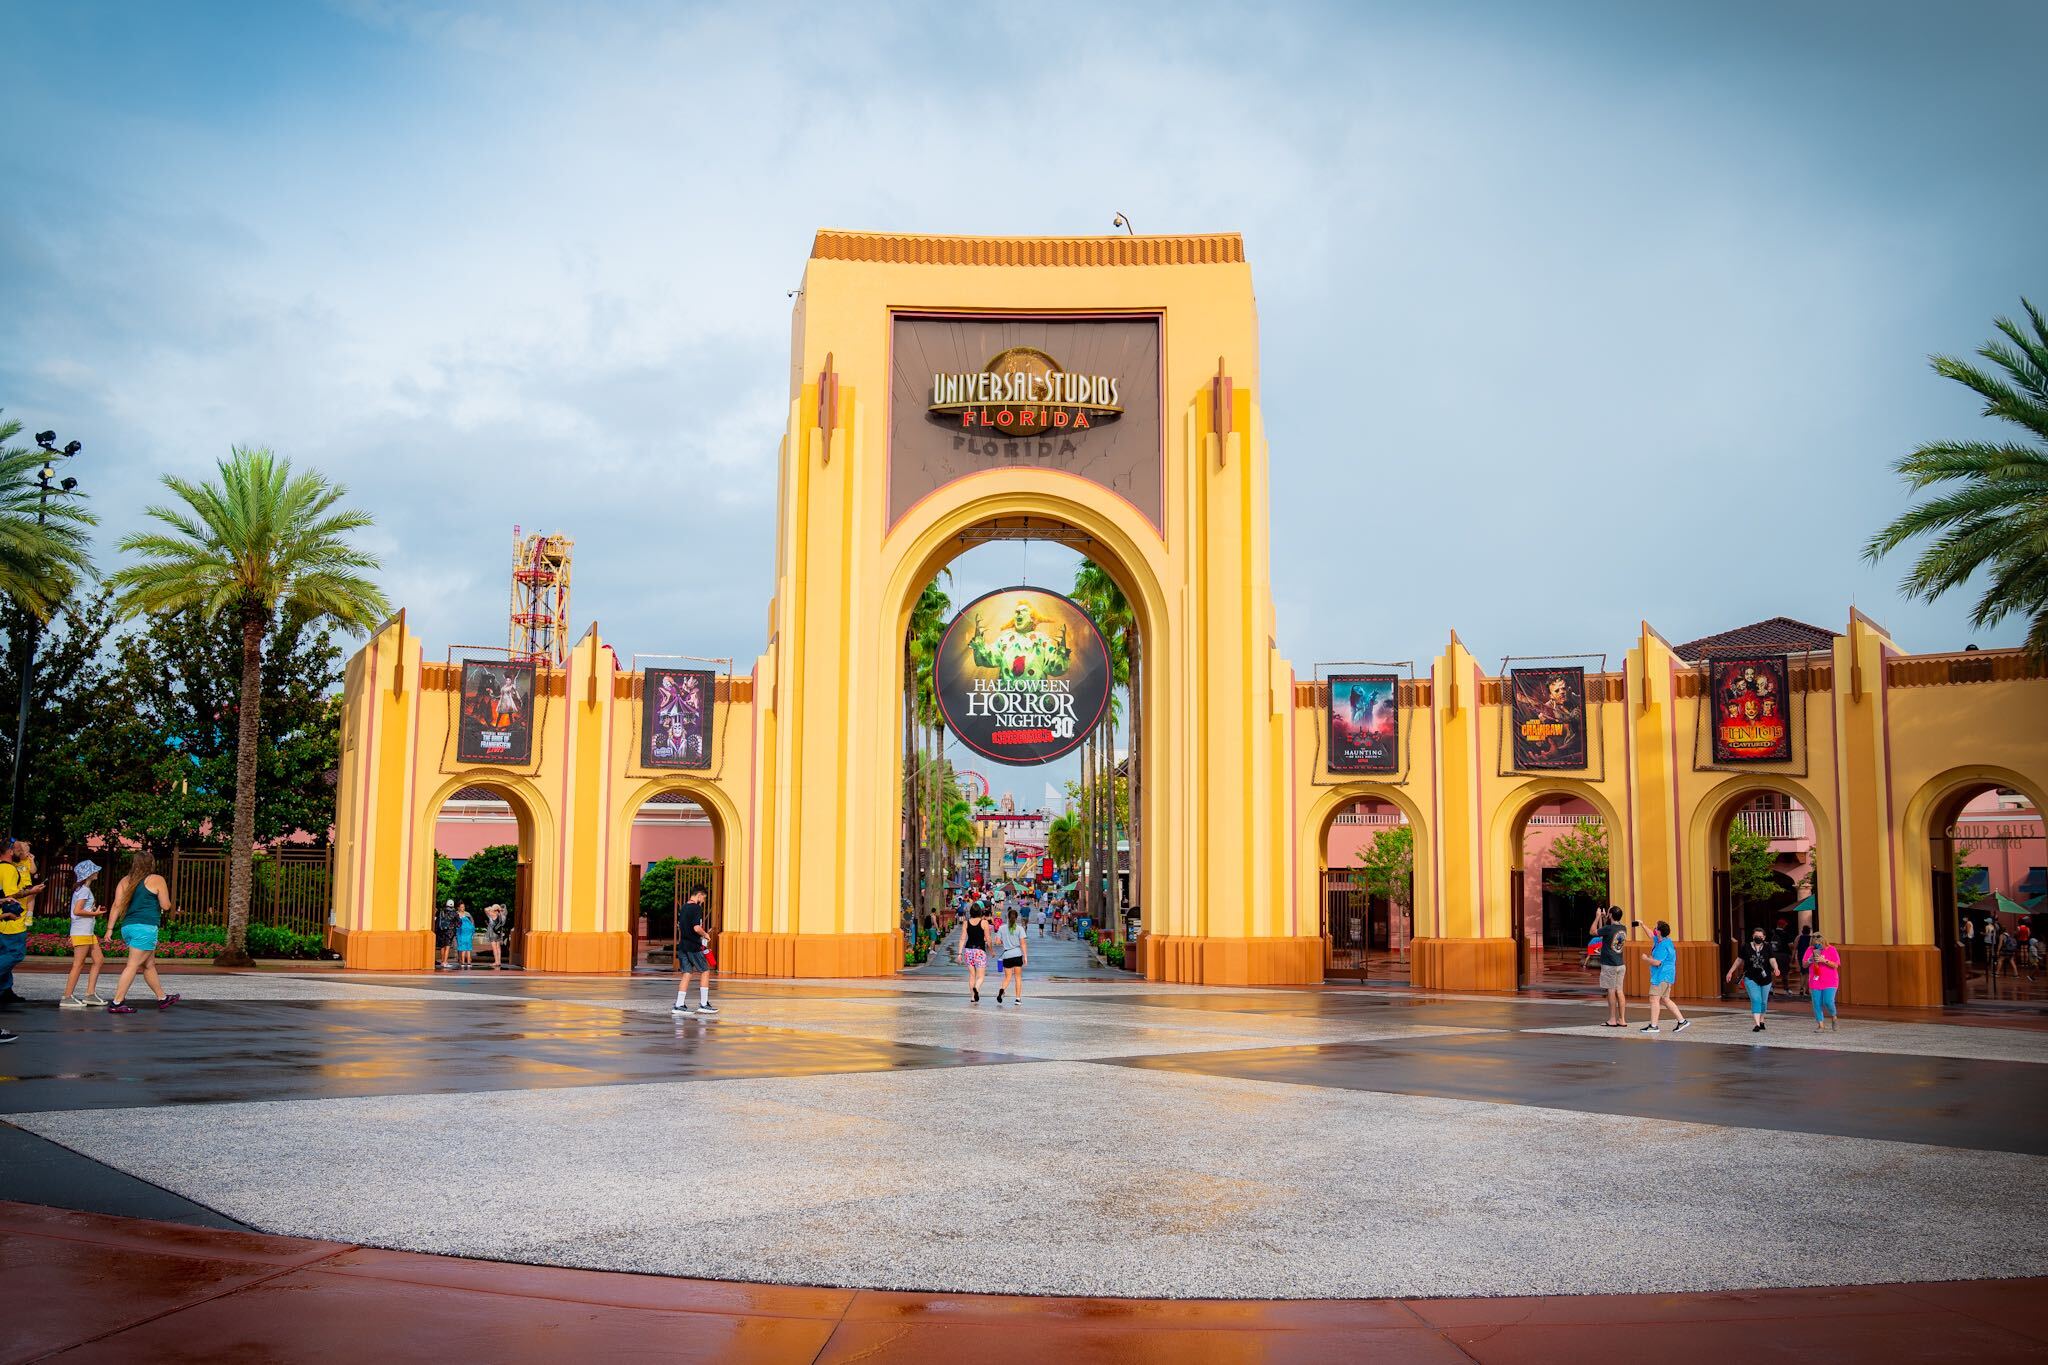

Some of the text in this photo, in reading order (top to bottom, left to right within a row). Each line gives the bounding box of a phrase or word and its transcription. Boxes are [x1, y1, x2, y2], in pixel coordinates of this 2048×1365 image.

[934, 369, 1119, 406] UNIVERSAL STUDIOS
[963, 410, 1090, 428] FLORIDA
[973, 679, 1071, 693] HALLOWEEN
[966, 692, 1079, 722] HORROR
[995, 714, 1076, 738] NIGHTS 30
[1946, 823, 2035, 838] GROUP SALES
